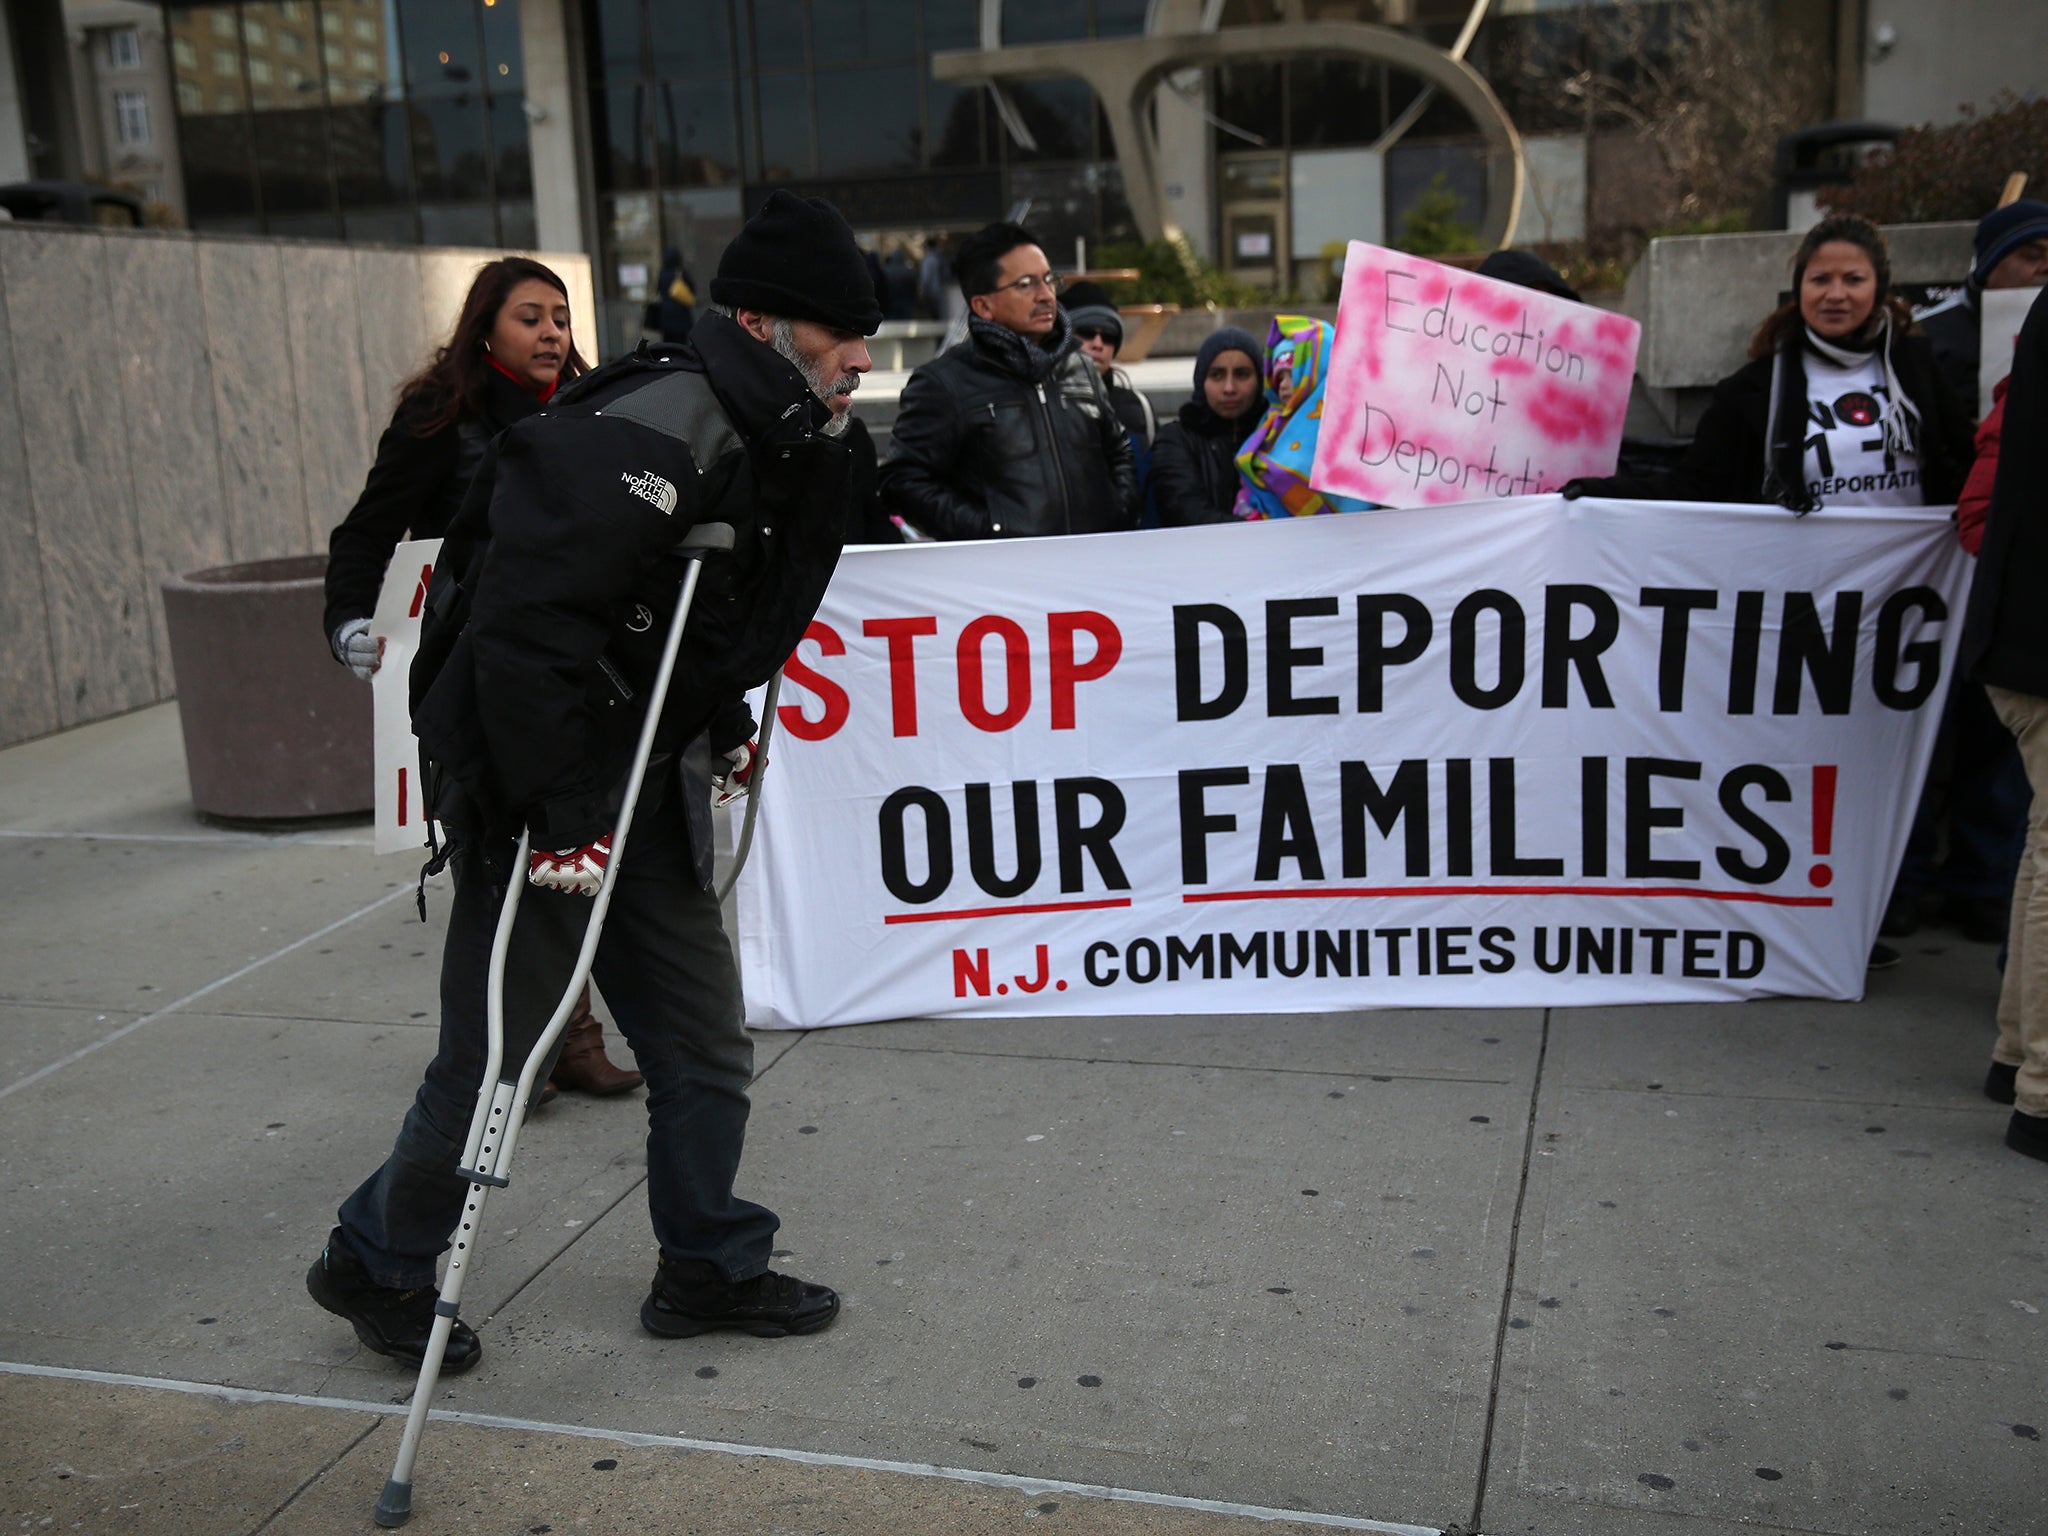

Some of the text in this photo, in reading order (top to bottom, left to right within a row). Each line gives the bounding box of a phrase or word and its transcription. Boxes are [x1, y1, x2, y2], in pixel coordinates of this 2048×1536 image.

[1385, 270, 1585, 381] Education
[1431, 363, 1508, 423] Not
[621, 472, 664, 497] NORTH
[628, 485, 660, 505] FACE
[643, 470, 667, 488] THE
[777, 583, 1949, 742] STOP DEPORTING
[878, 756, 1838, 905] OUR FAMILIES!
[952, 926, 1766, 998] N.J. COMMUNITIES UNITED
